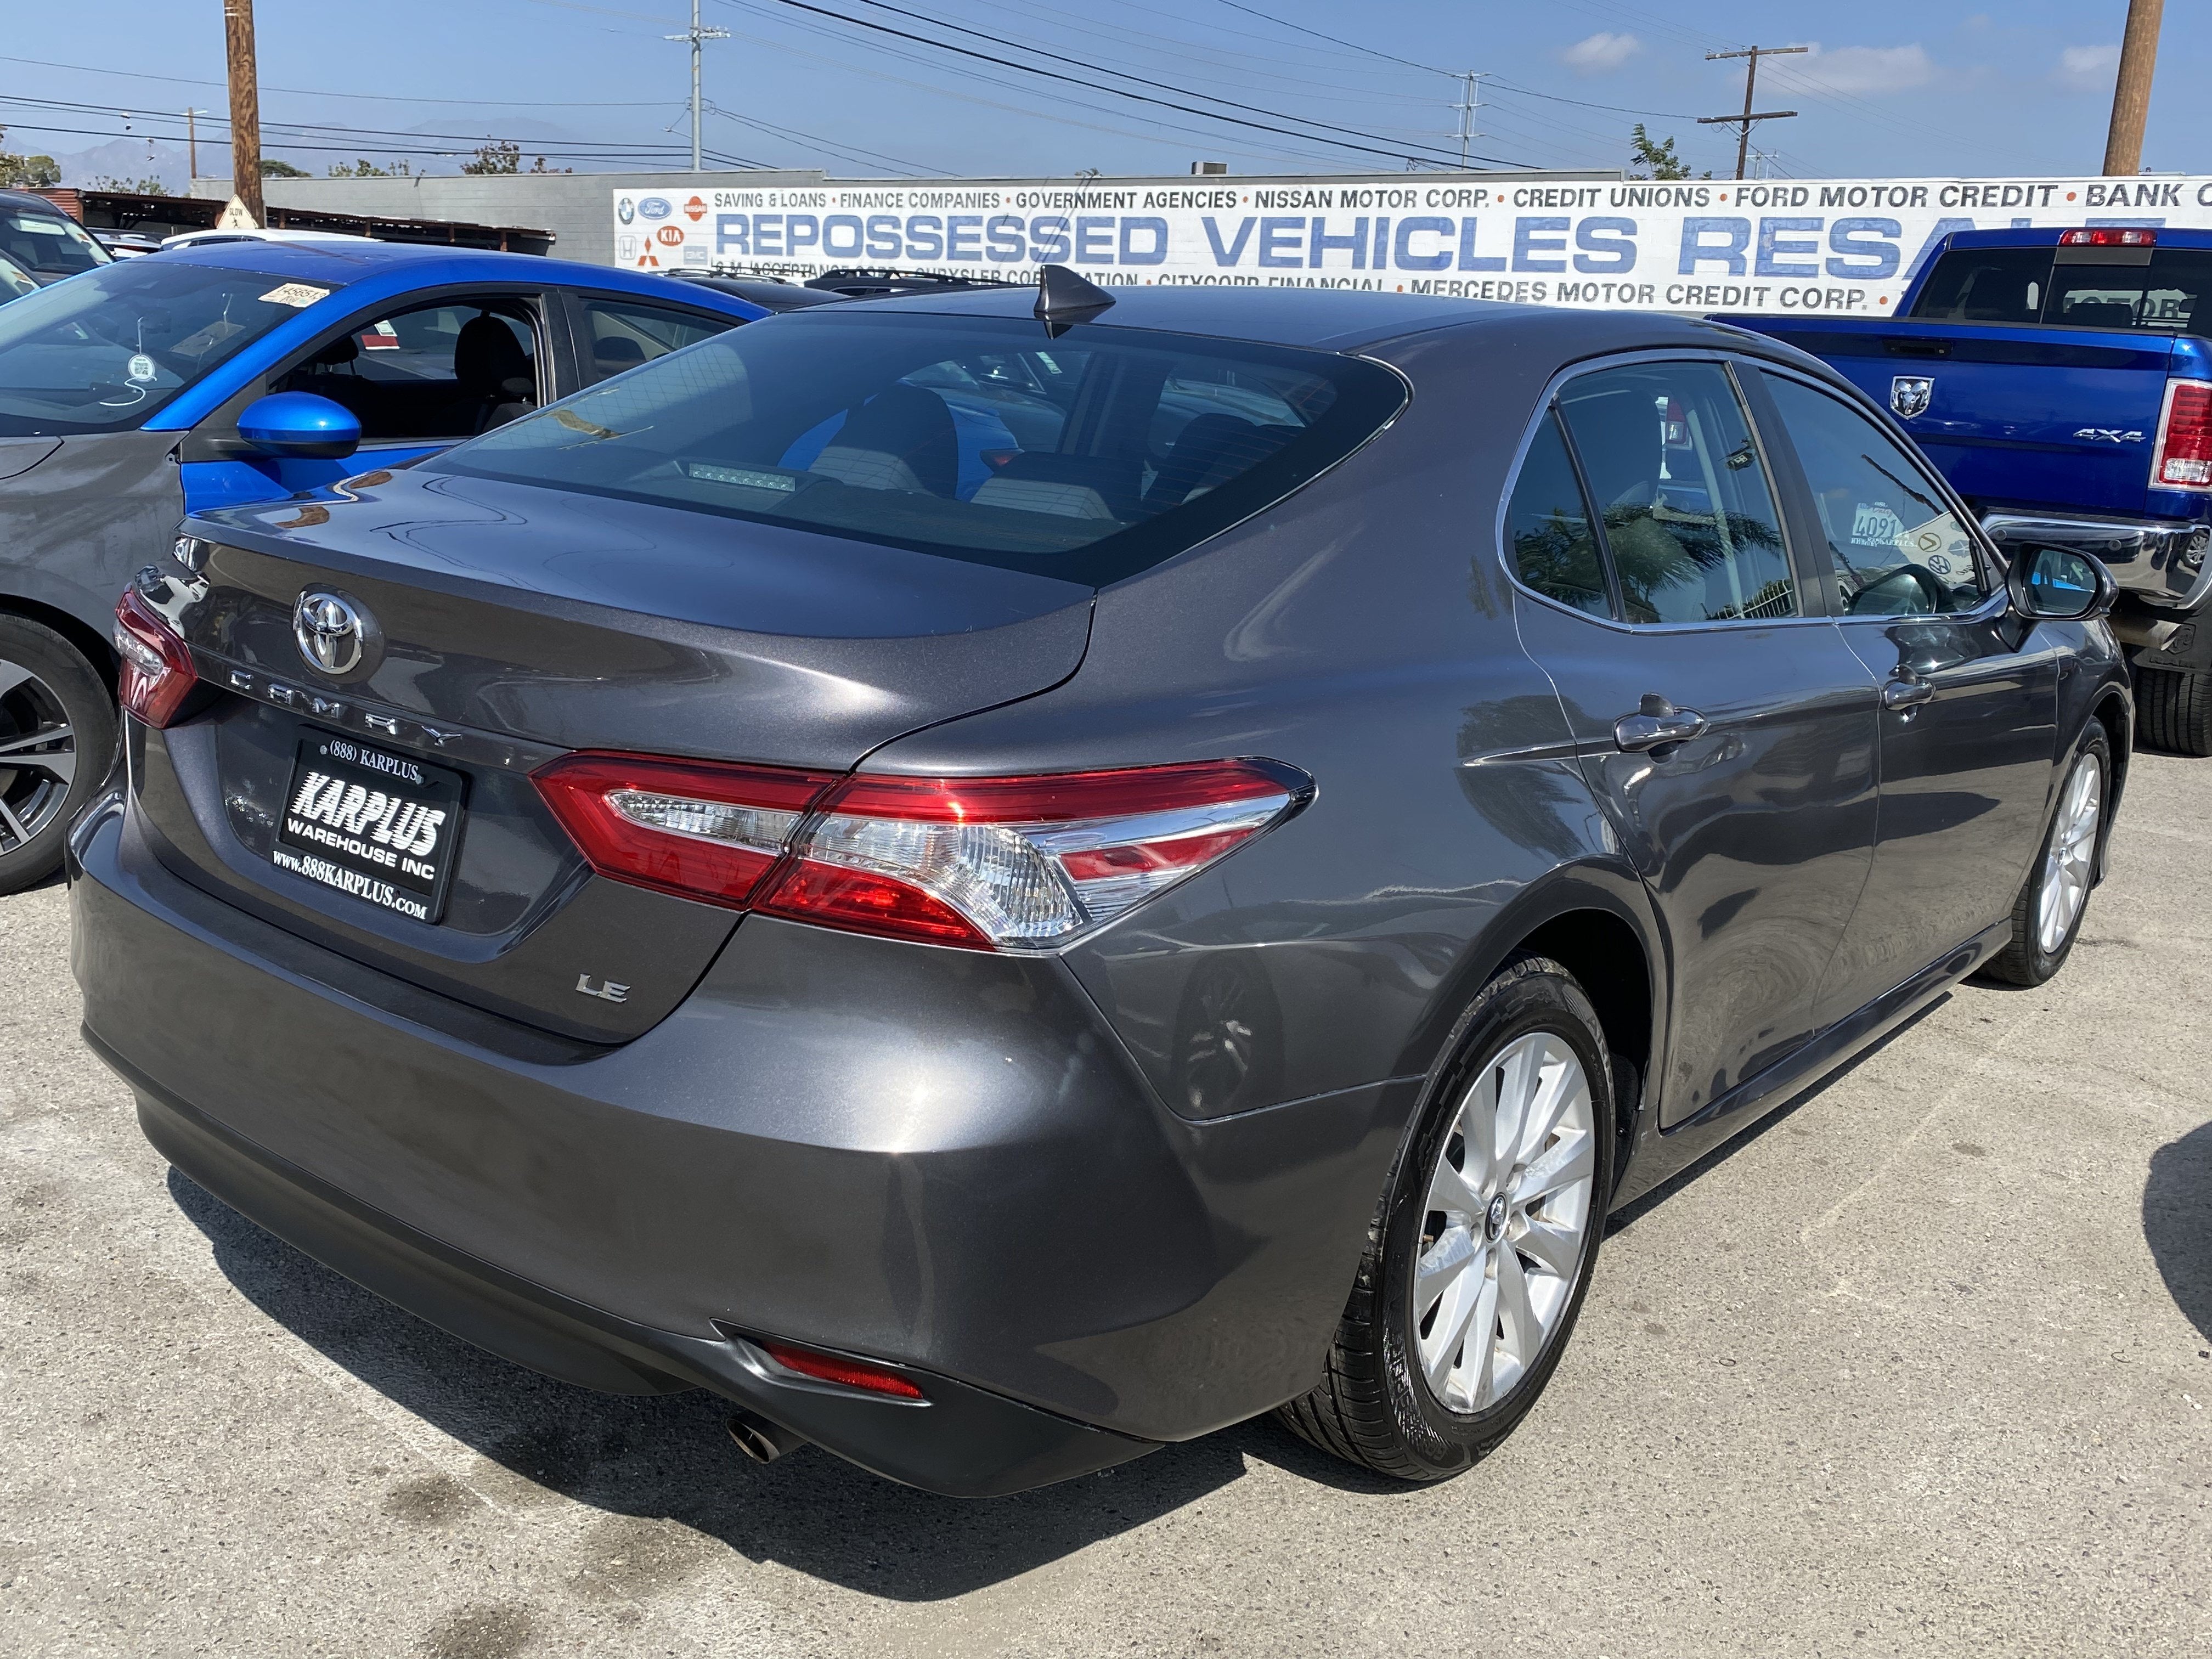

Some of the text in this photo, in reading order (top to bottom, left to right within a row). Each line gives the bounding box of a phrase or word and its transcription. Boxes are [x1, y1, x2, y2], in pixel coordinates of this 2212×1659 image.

[714, 193, 826, 208] SAVING & LOANS
[840, 192, 1000, 208] FINANCE COMPANIES
[1016, 191, 1237, 208] GOVERNMENT AGENCIES
[1255, 189, 1490, 208] NISSAN MOTOR CORP.
[1514, 187, 1711, 207] CREDIT UNIONS
[1735, 184, 2059, 207] FORD MOTOR CREDIT
[2085, 183, 2185, 207] BANK
[644, 201, 664, 215] Ford
[660, 229, 681, 242] KIA
[716, 213, 2166, 281] REPOSSESSED VEHICLES RESA
[1410, 279, 1867, 311] MERCEDES MOTOR CREDIT CORP.
[230, 669, 463, 747] CAMRY
[330, 740, 419, 781] (888) KARPLUS
[289, 771, 447, 856] KARPLUS
[287, 817, 436, 880] WAREHOUSE INC
[575, 973, 631, 1003] LE
